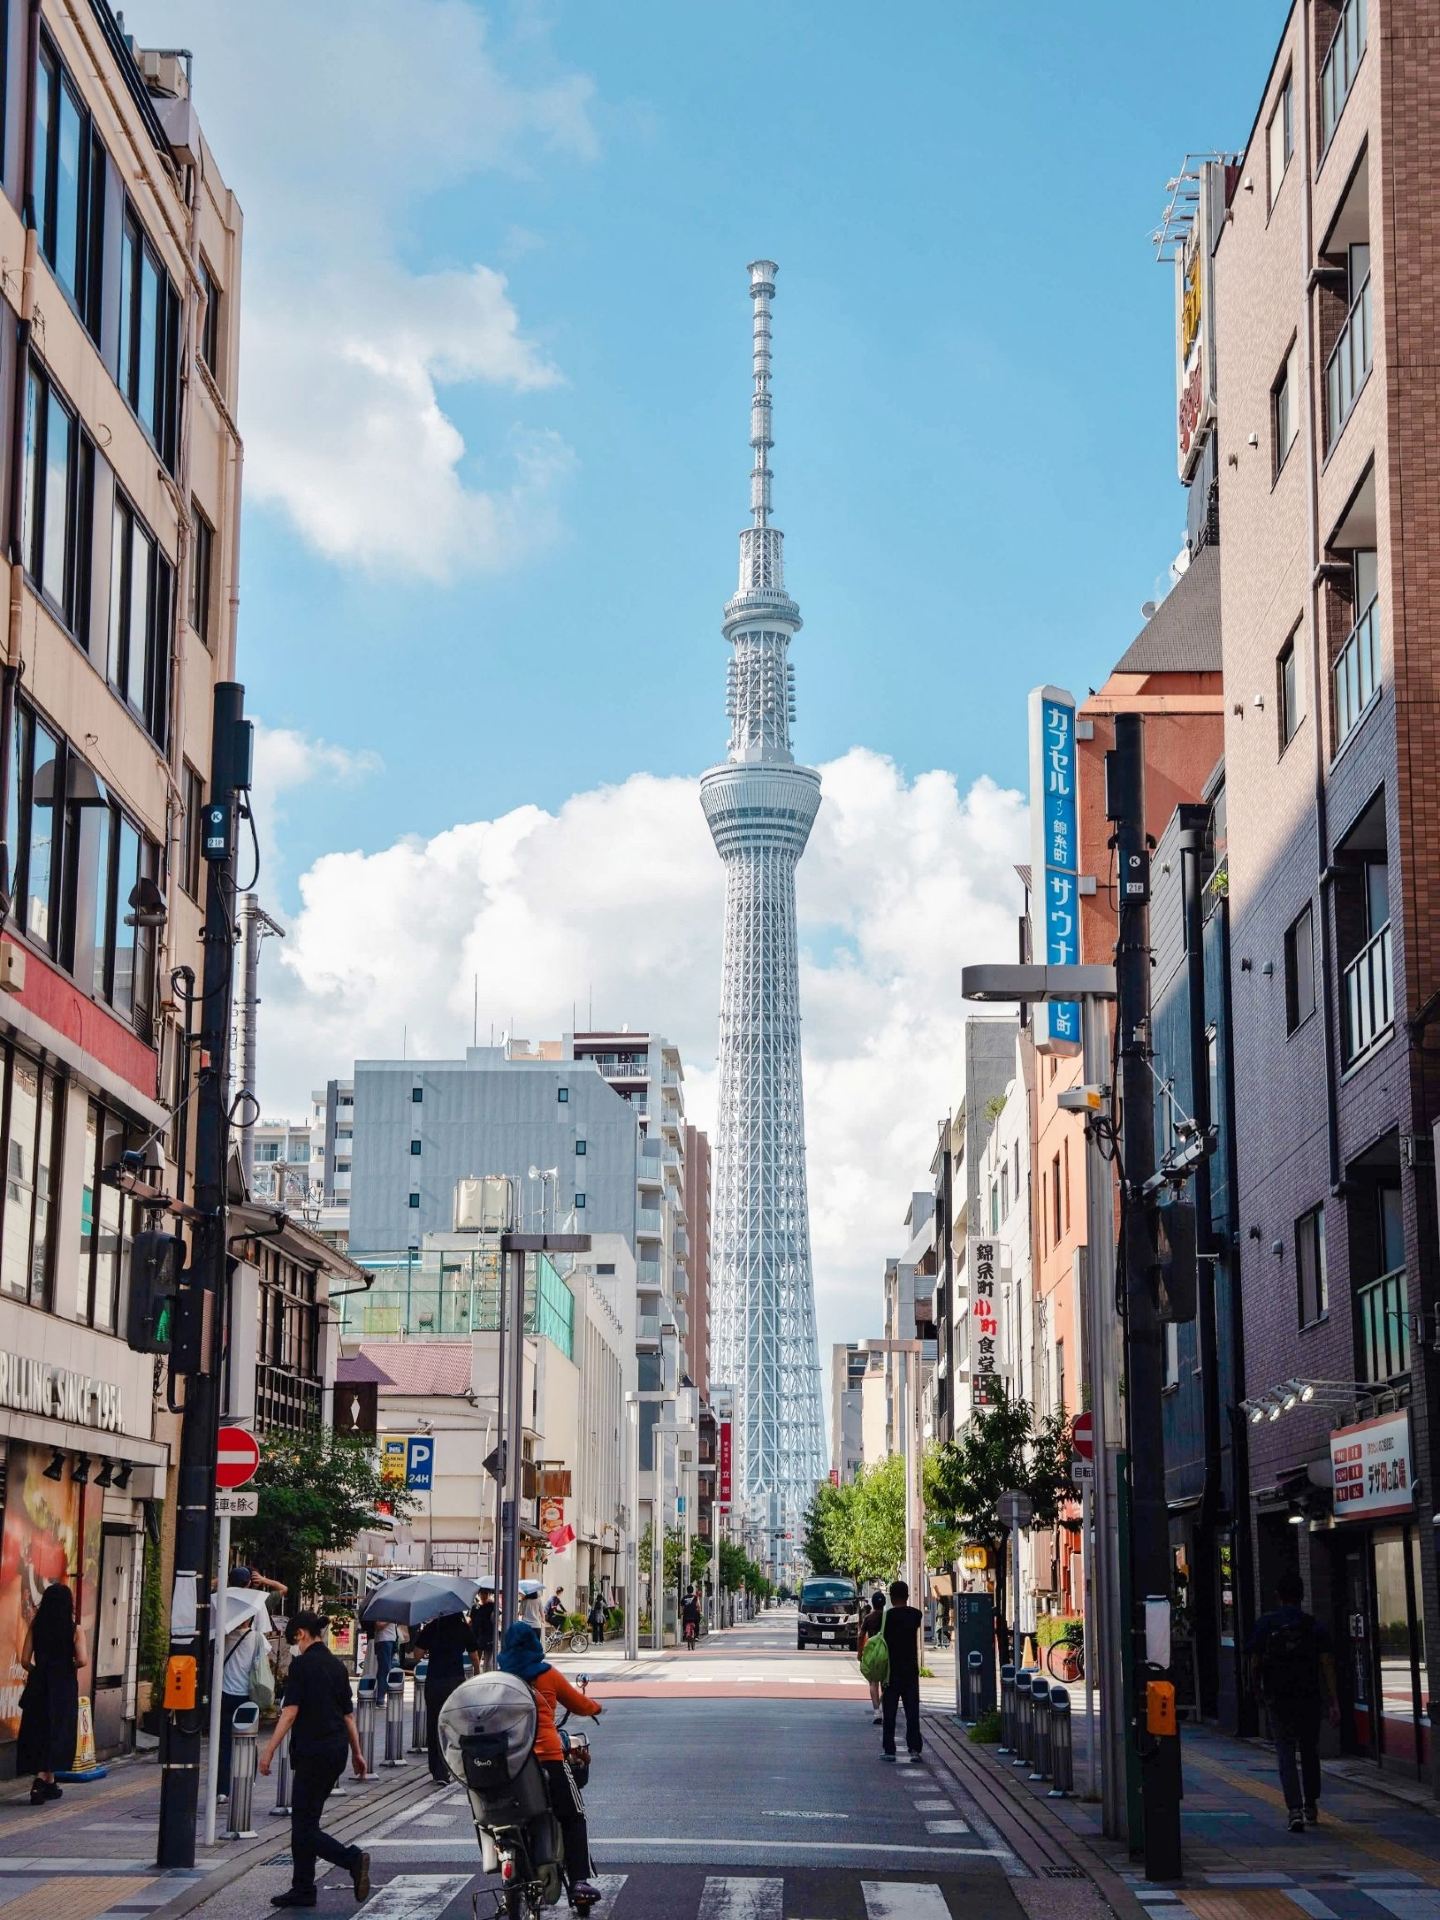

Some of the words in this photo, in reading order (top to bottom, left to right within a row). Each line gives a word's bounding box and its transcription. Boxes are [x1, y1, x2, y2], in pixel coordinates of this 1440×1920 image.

[57, 1367, 93, 1427] SINCE
[411, 1444, 430, 1469] P
[408, 1474, 429, 1483] 24H
[1074, 1467, 1095, 1478] 自転
